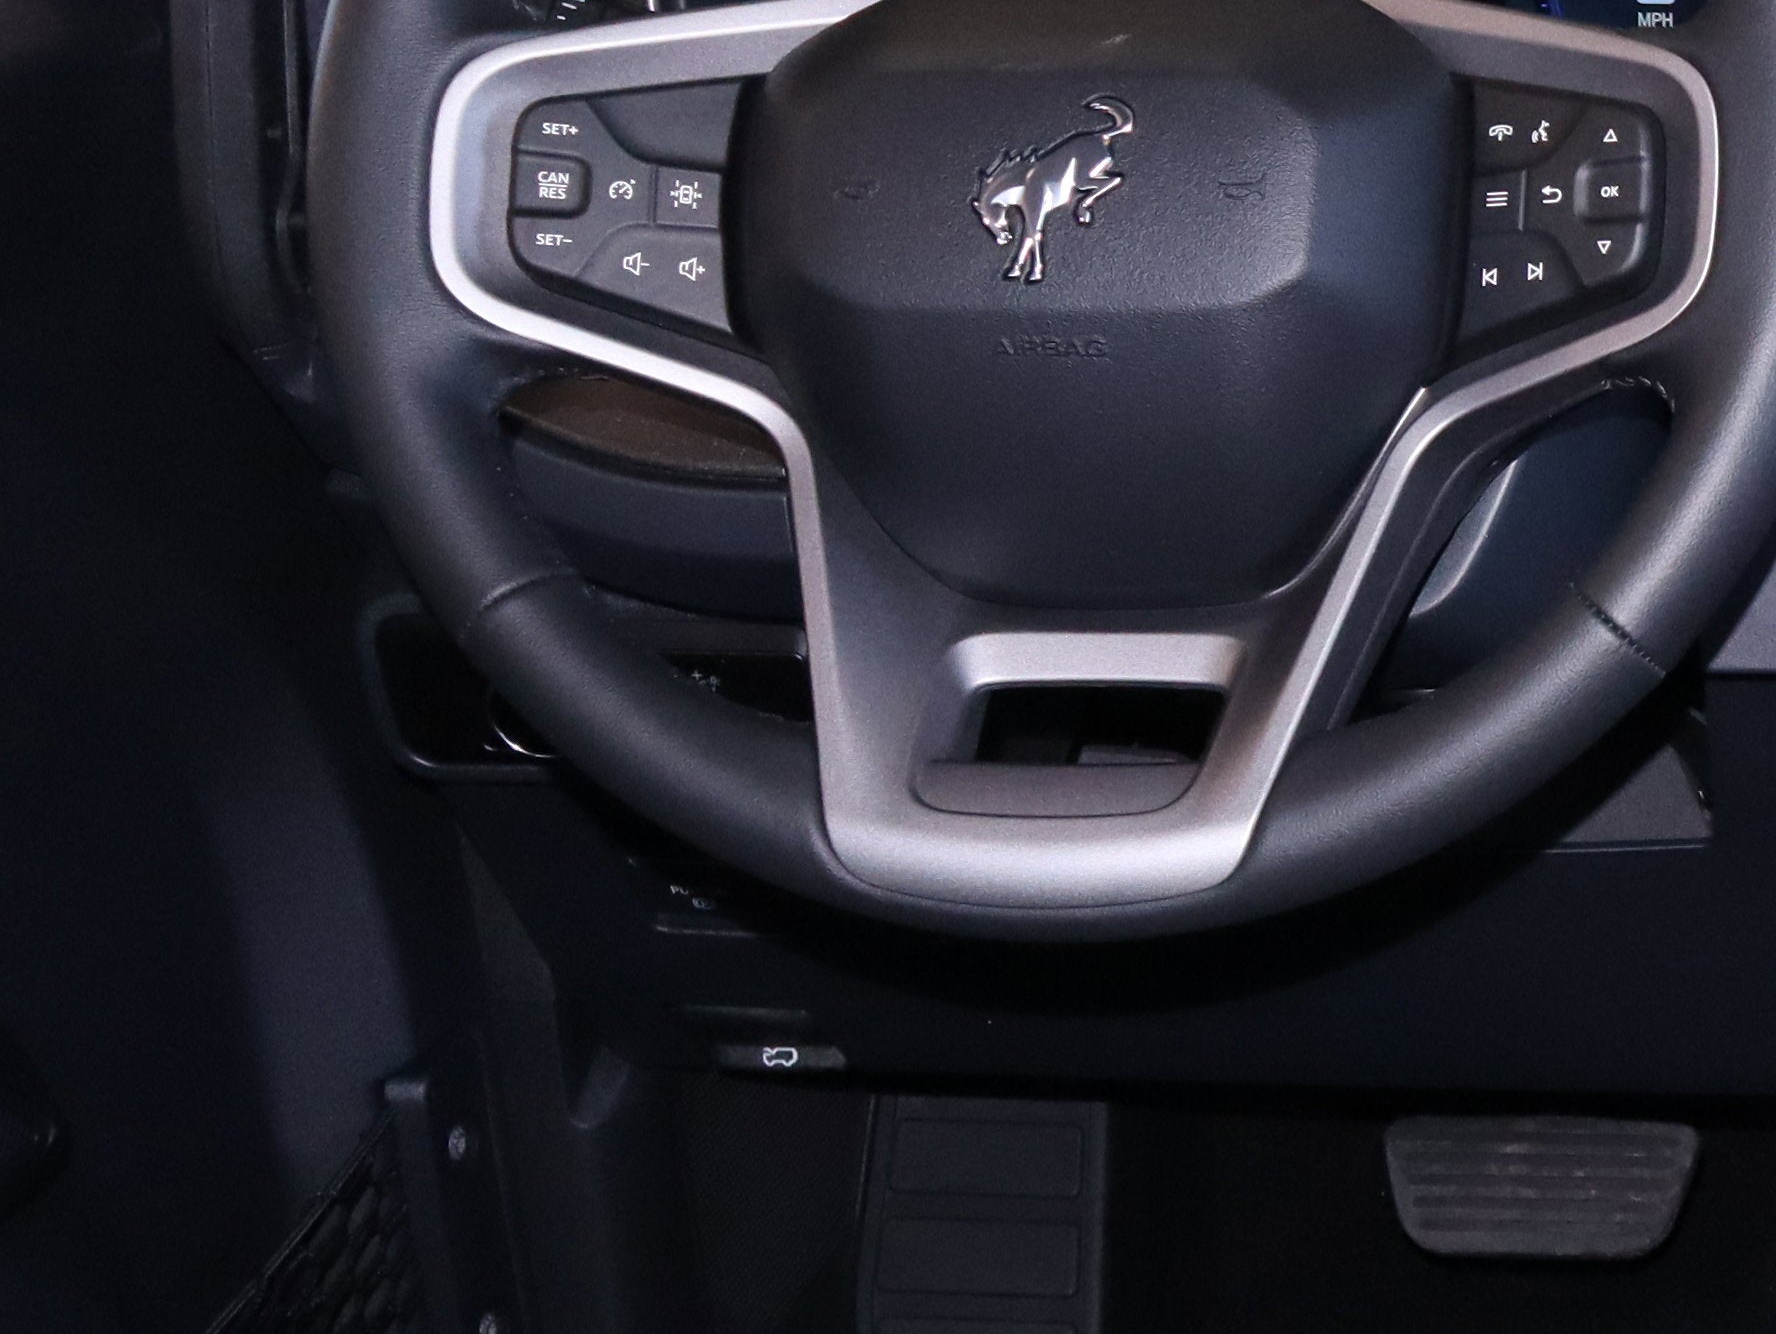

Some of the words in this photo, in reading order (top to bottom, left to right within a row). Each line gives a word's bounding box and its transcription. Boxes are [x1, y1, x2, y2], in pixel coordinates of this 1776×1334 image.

[1637, 12, 1673, 27] MPH
[542, 123, 578, 136] SET+
[538, 171, 569, 184] CAN
[539, 186, 567, 199] RES
[1601, 185, 1619, 198] OK
